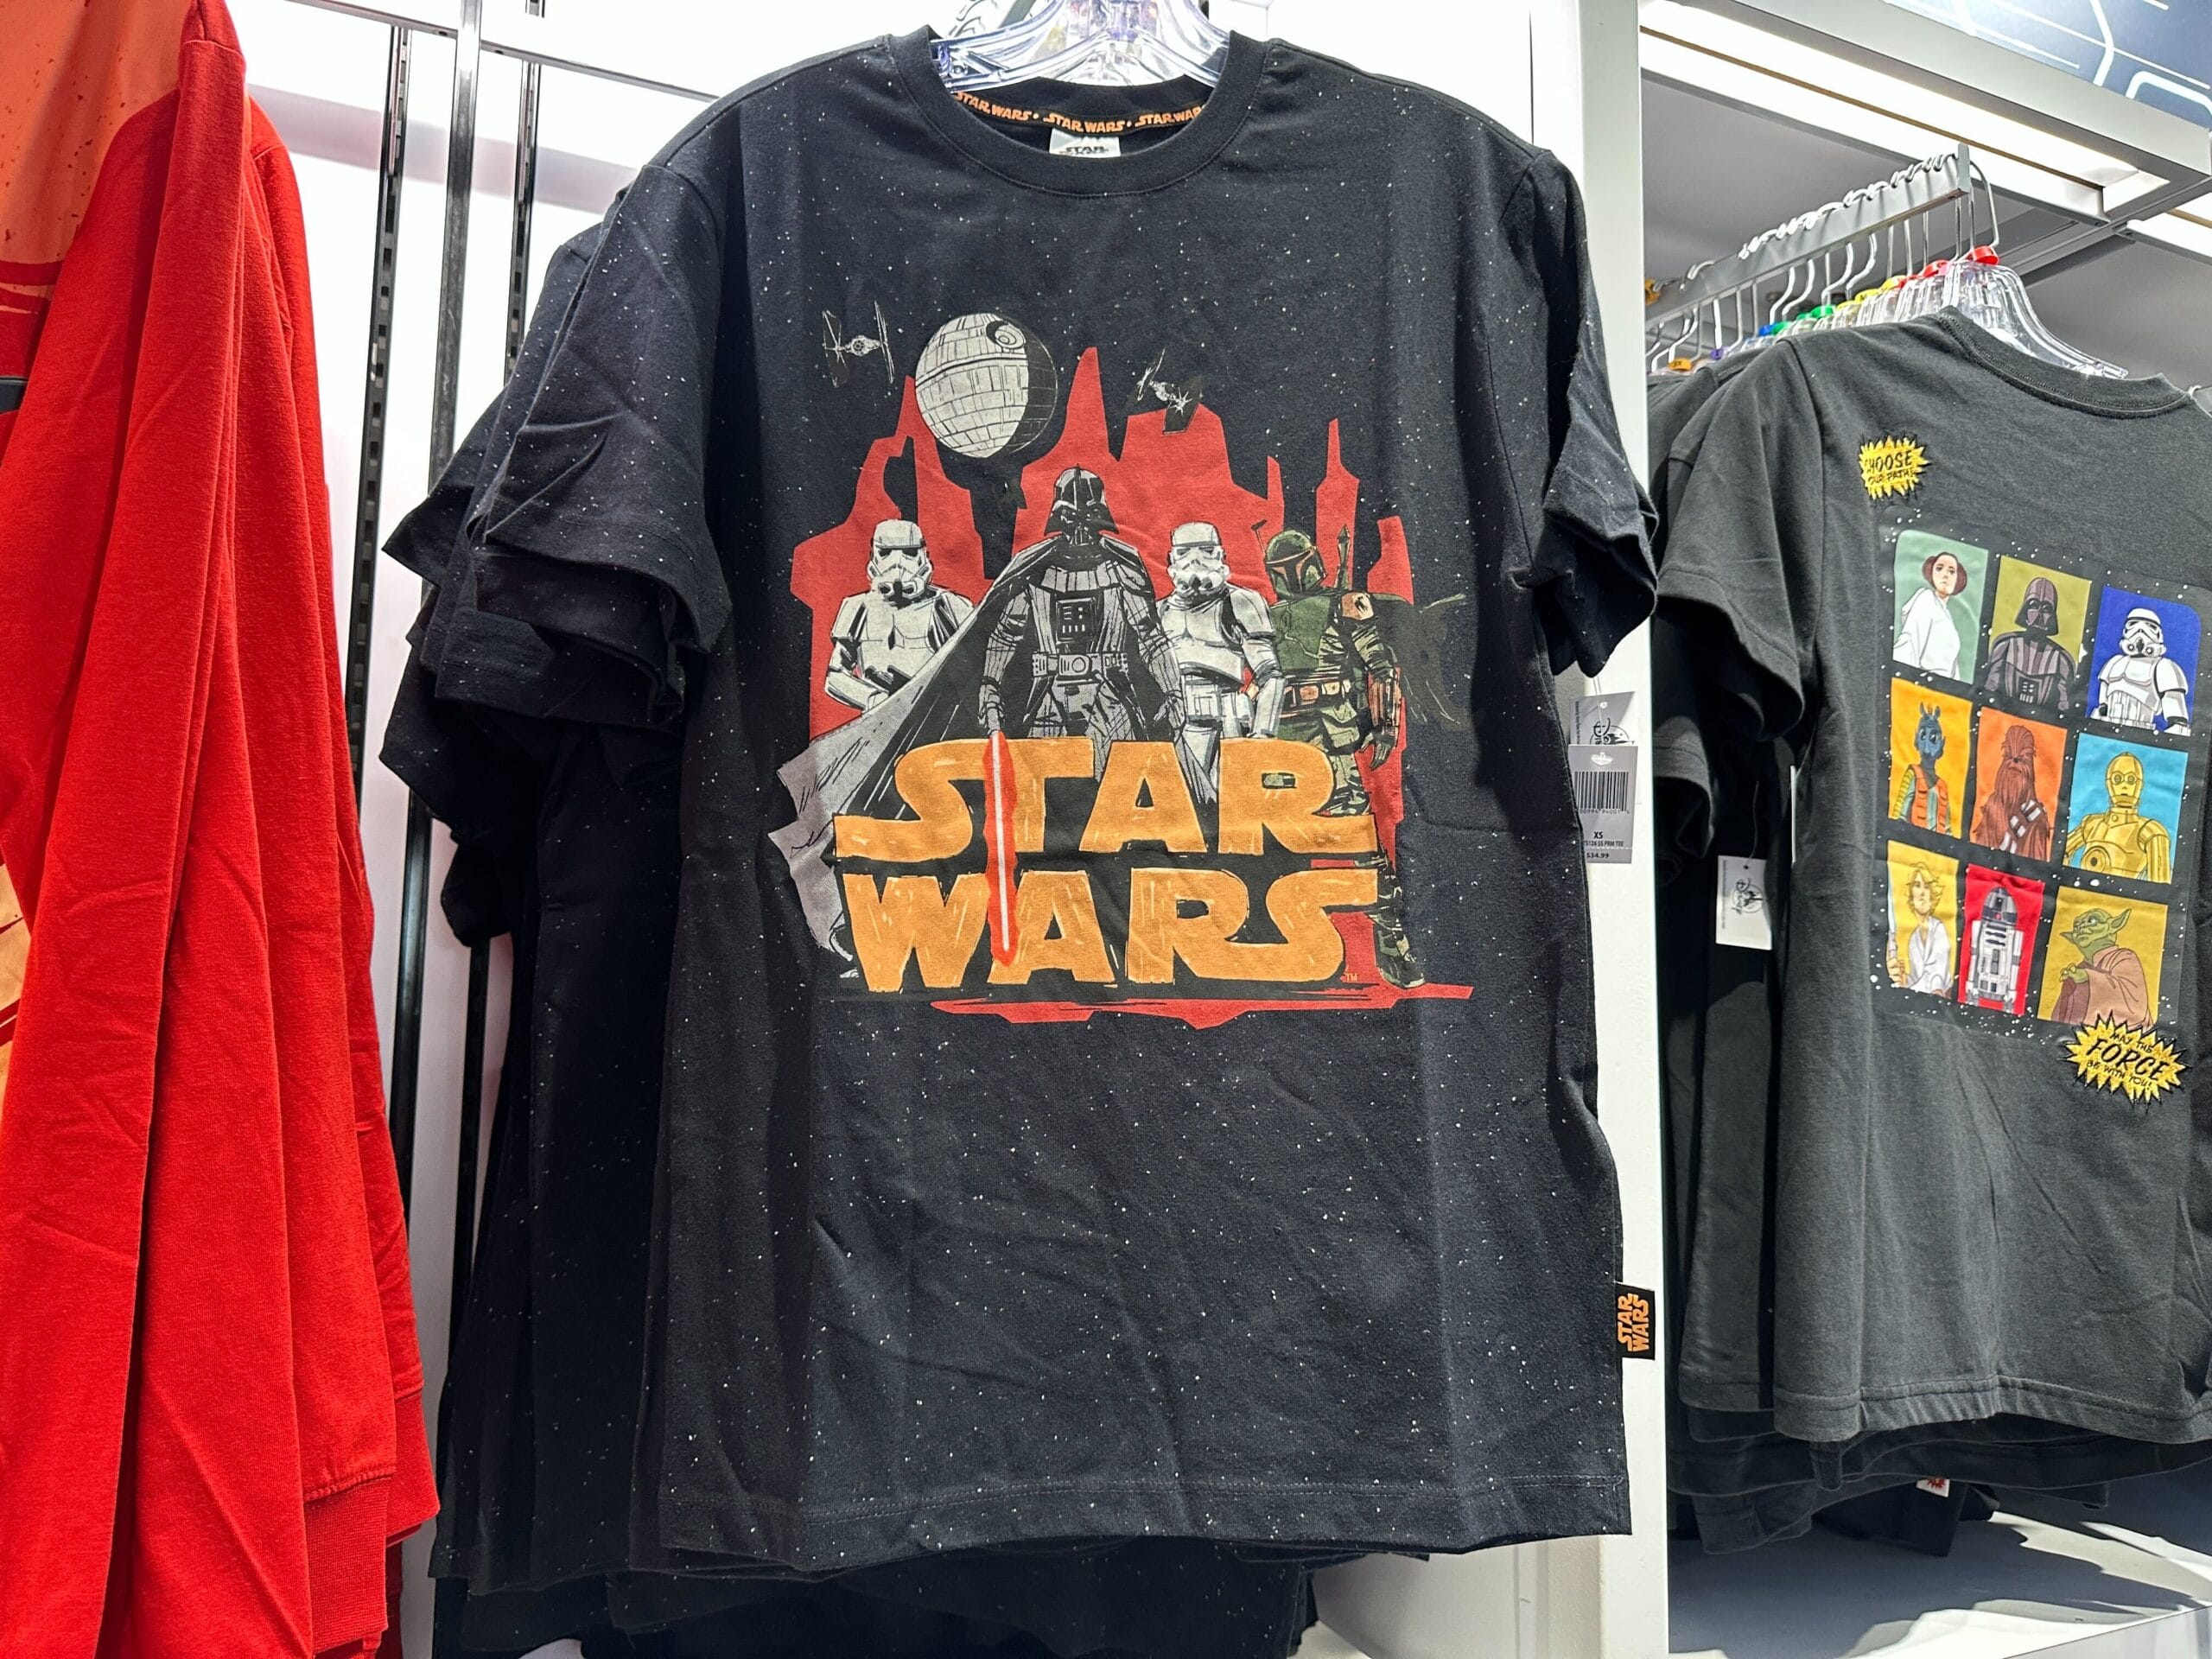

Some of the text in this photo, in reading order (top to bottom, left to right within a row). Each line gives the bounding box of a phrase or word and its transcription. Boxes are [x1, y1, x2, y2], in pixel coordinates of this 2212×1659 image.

[954, 91, 1033, 121] STAR WARS
[1135, 105, 1205, 127] STAR WAR
[1043, 113, 1126, 133] STAR WARS
[1059, 146, 1109, 155] STAR
[833, 737, 1378, 862] STAR
[842, 868, 1378, 993] WARS
[2110, 1033, 2152, 1053] MAY THE
[2086, 1038, 2170, 1081] FORCE
[2087, 1060, 2100, 1069] BE
[2104, 1065, 2126, 1077] WITH
[1618, 1293, 1632, 1351] STAR
[1632, 1294, 1649, 1352] WARS
